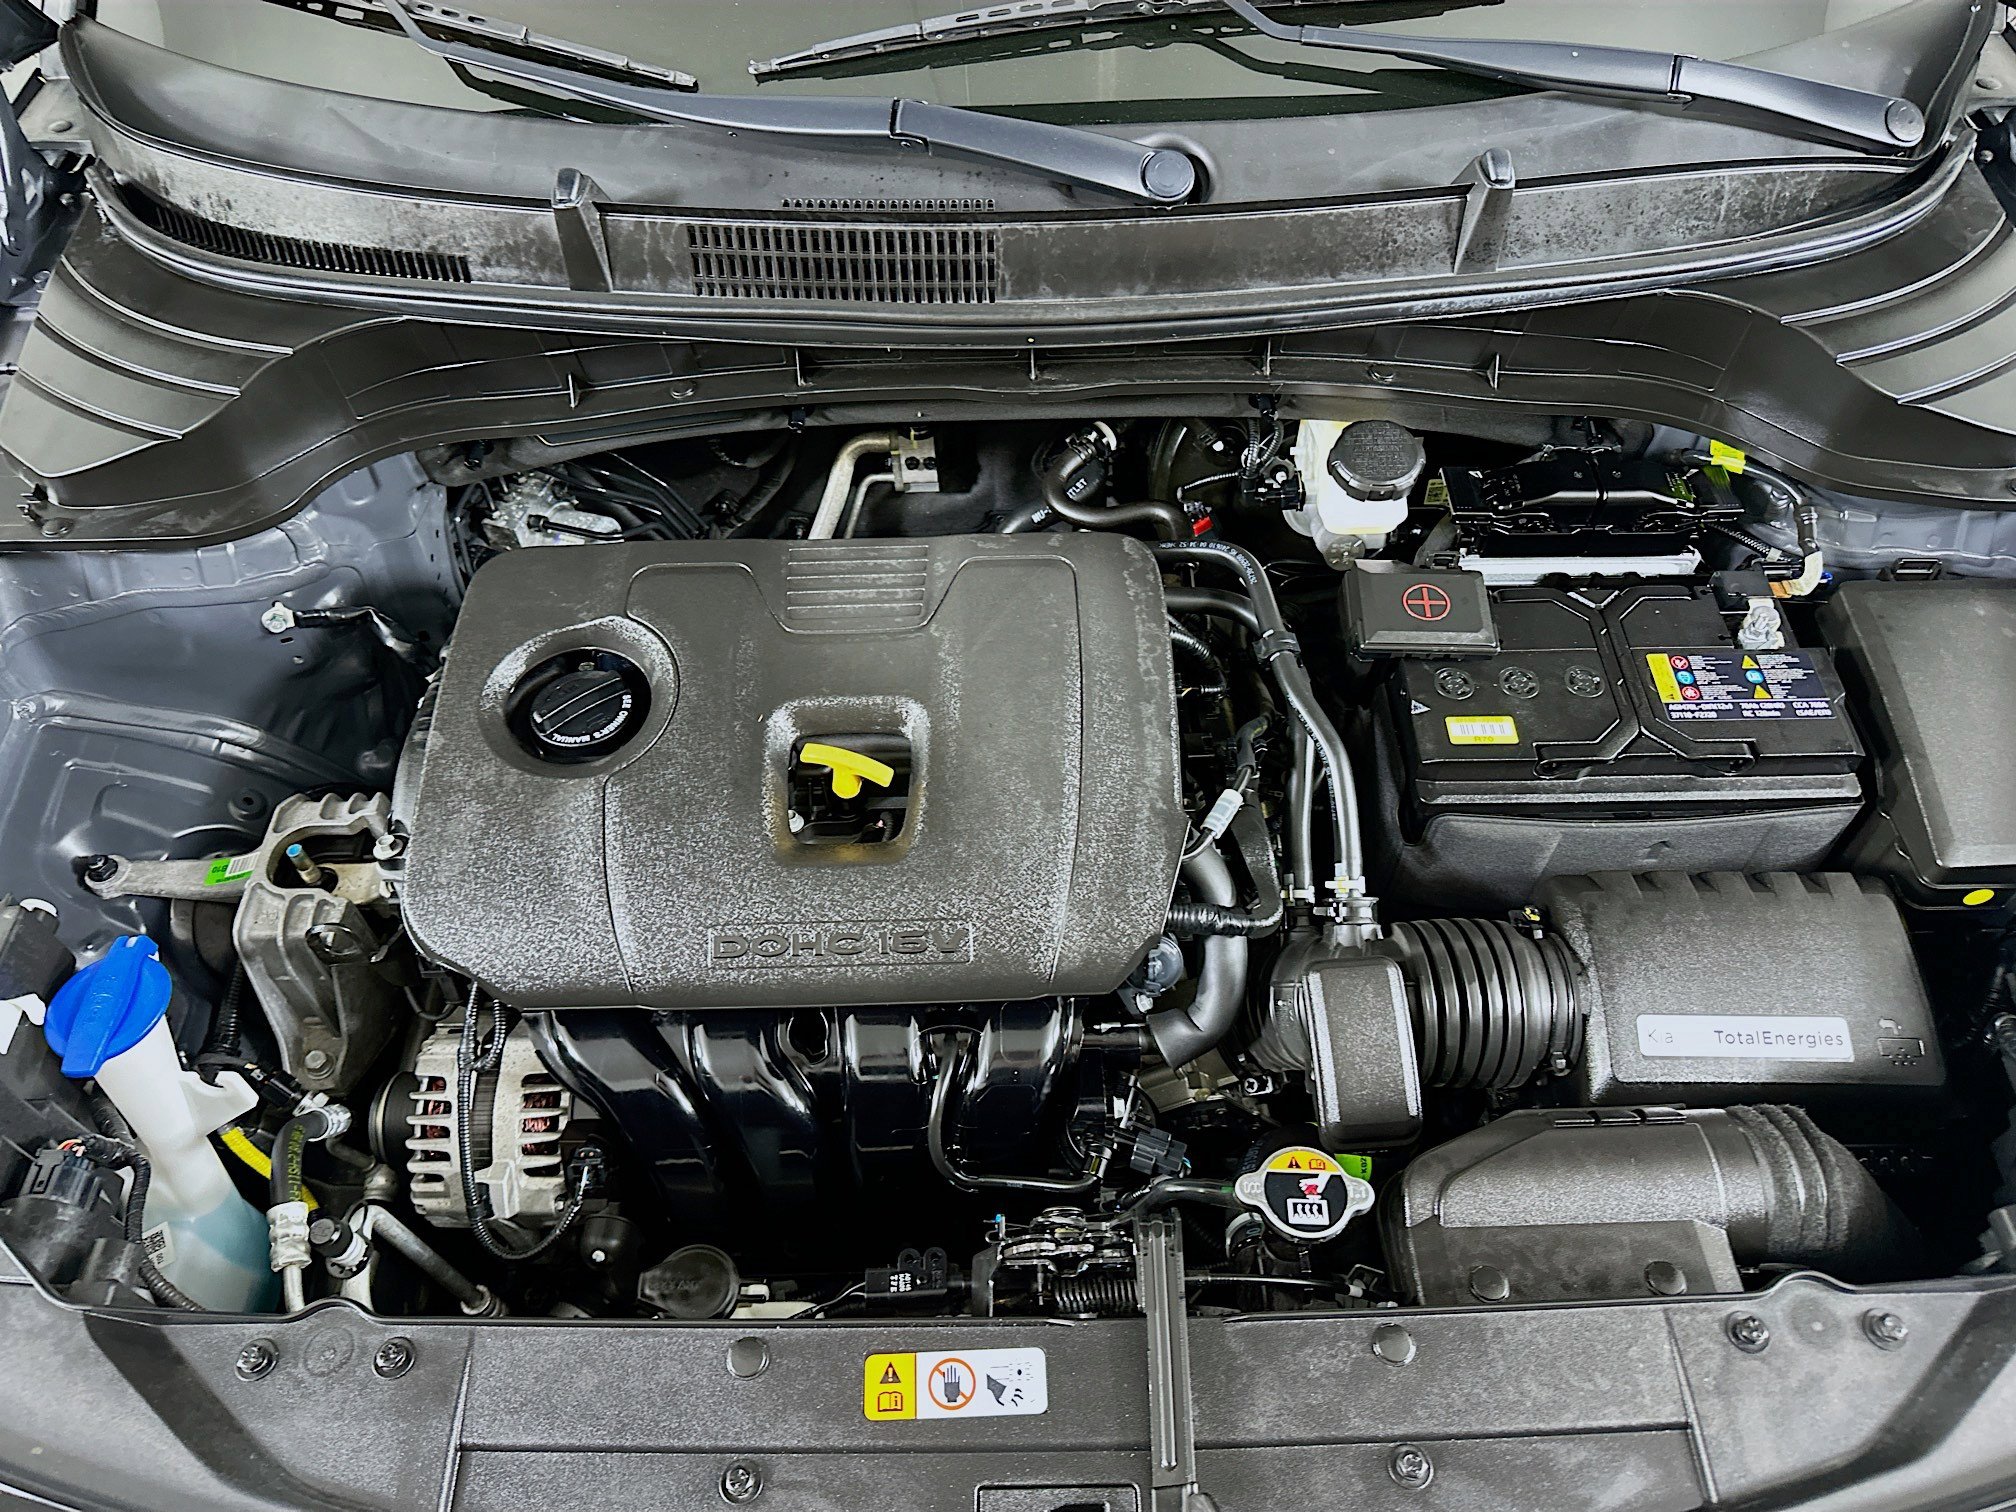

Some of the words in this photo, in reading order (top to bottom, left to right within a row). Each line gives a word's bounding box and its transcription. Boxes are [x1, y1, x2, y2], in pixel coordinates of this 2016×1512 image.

[552, 732, 591, 743] MANUAL
[713, 933, 863, 959] DOHC
[877, 930, 969, 955] 16V
[1713, 1030, 1844, 1048] TotalEnergies
